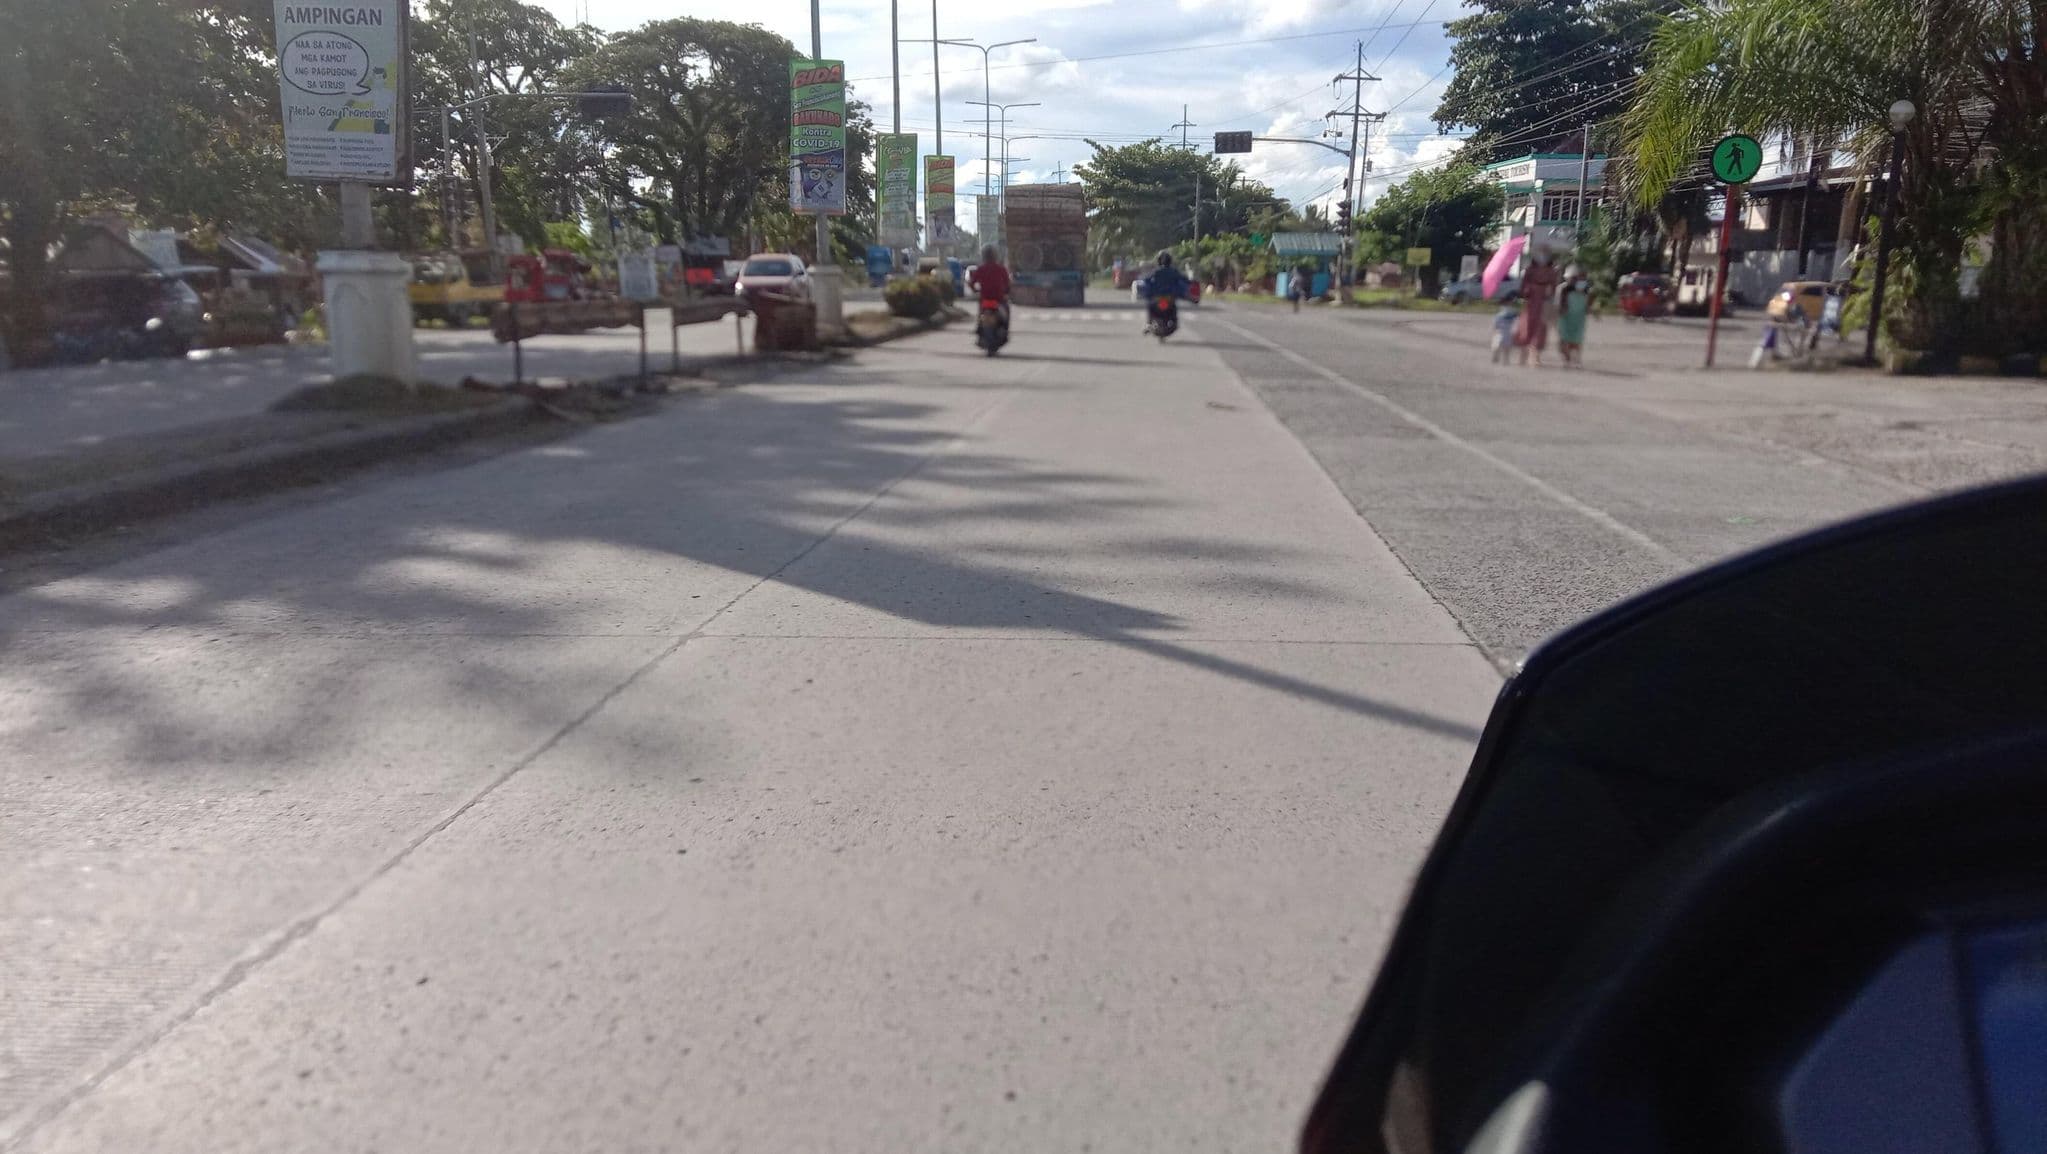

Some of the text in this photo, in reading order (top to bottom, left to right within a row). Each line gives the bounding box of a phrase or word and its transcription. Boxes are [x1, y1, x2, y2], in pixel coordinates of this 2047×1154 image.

[284, 7, 383, 26] AMPINGAN
[313, 41, 323, 50] SA
[301, 54, 347, 63] MGA KAMOT
[792, 65, 842, 89] BIDA
[307, 81, 317, 89] SA
[802, 127, 832, 137] Kontra
[792, 139, 841, 149] COVID-19
